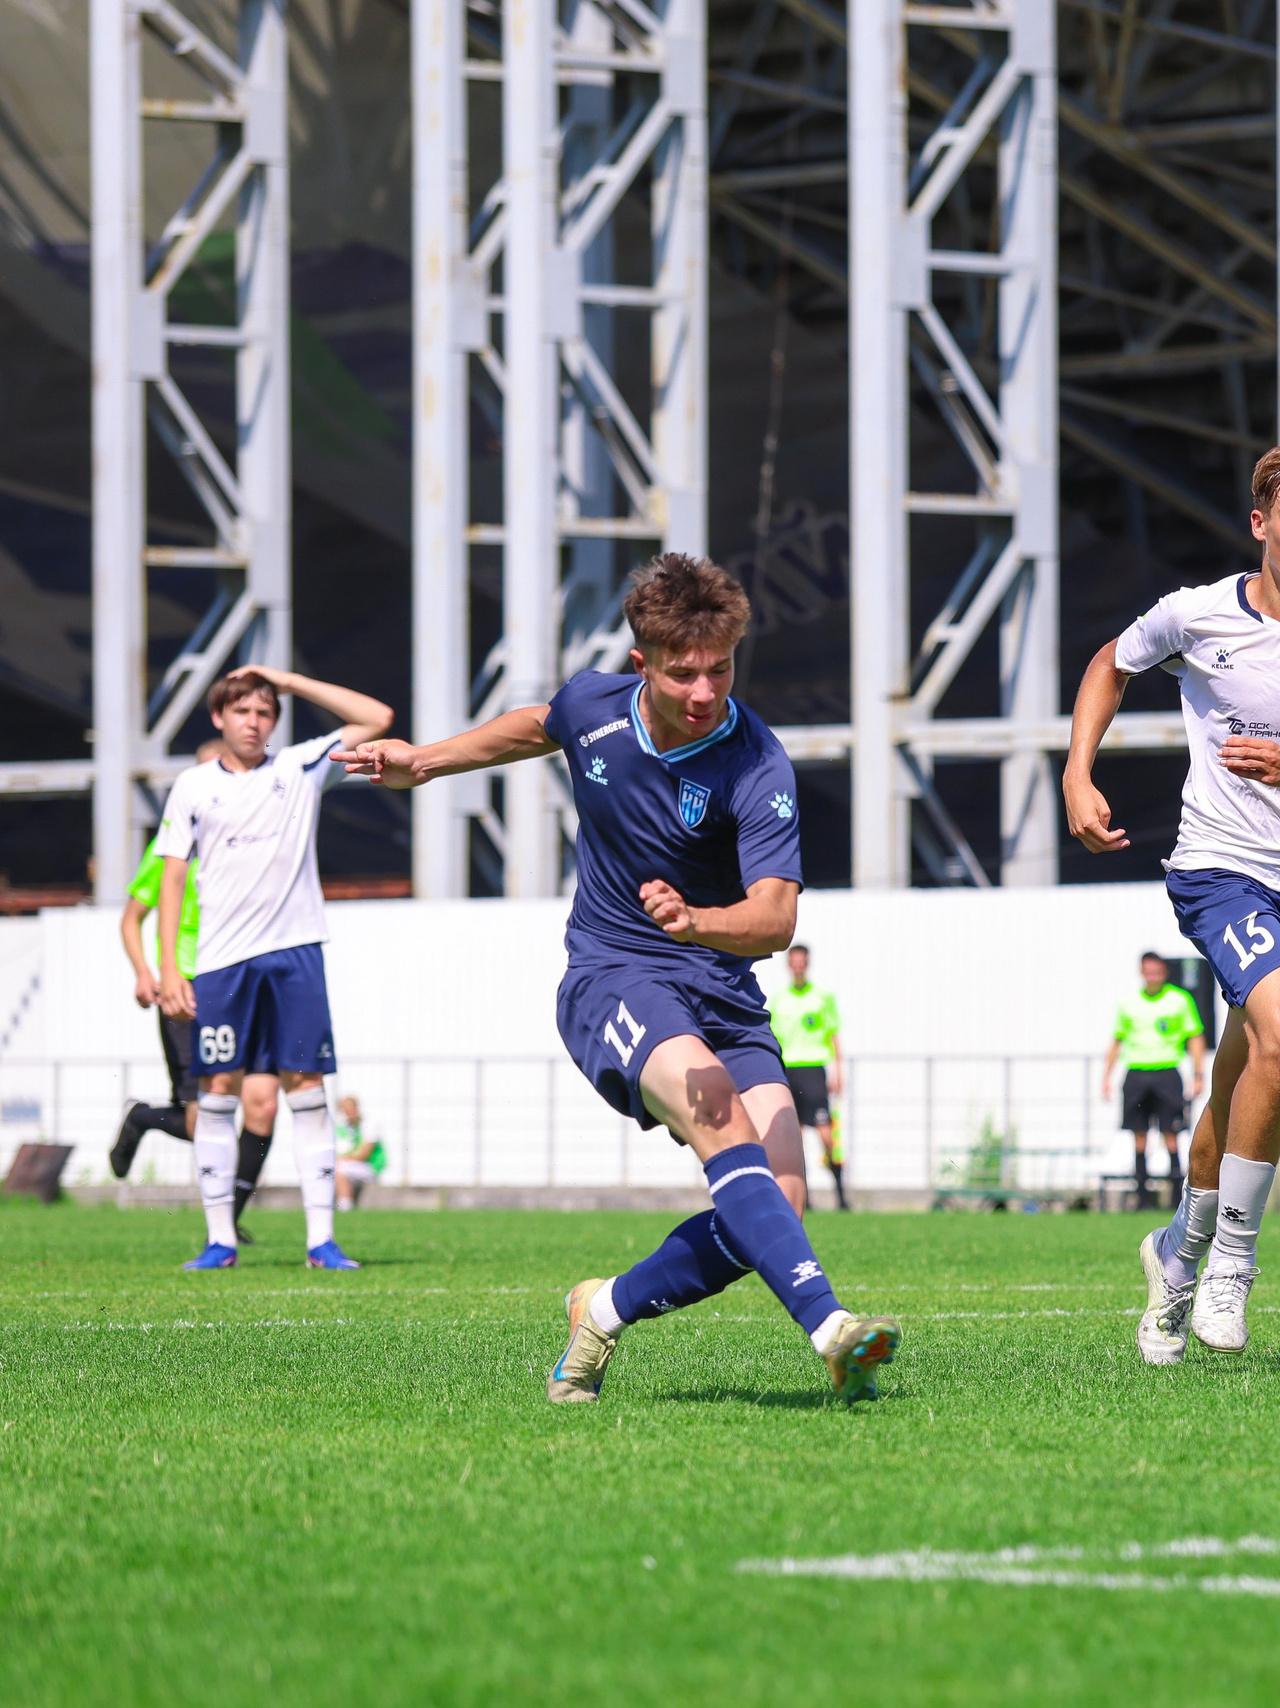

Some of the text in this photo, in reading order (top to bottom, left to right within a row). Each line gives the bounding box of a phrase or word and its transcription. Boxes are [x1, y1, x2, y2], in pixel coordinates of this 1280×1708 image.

[587, 717, 631, 744] SYNERGETIC
[1248, 721, 1270, 730] ДСК
[585, 770, 609, 786] KELME
[1223, 910, 1275, 972] 13
[199, 1024, 236, 1065] 69
[603, 1000, 647, 1068] 11
